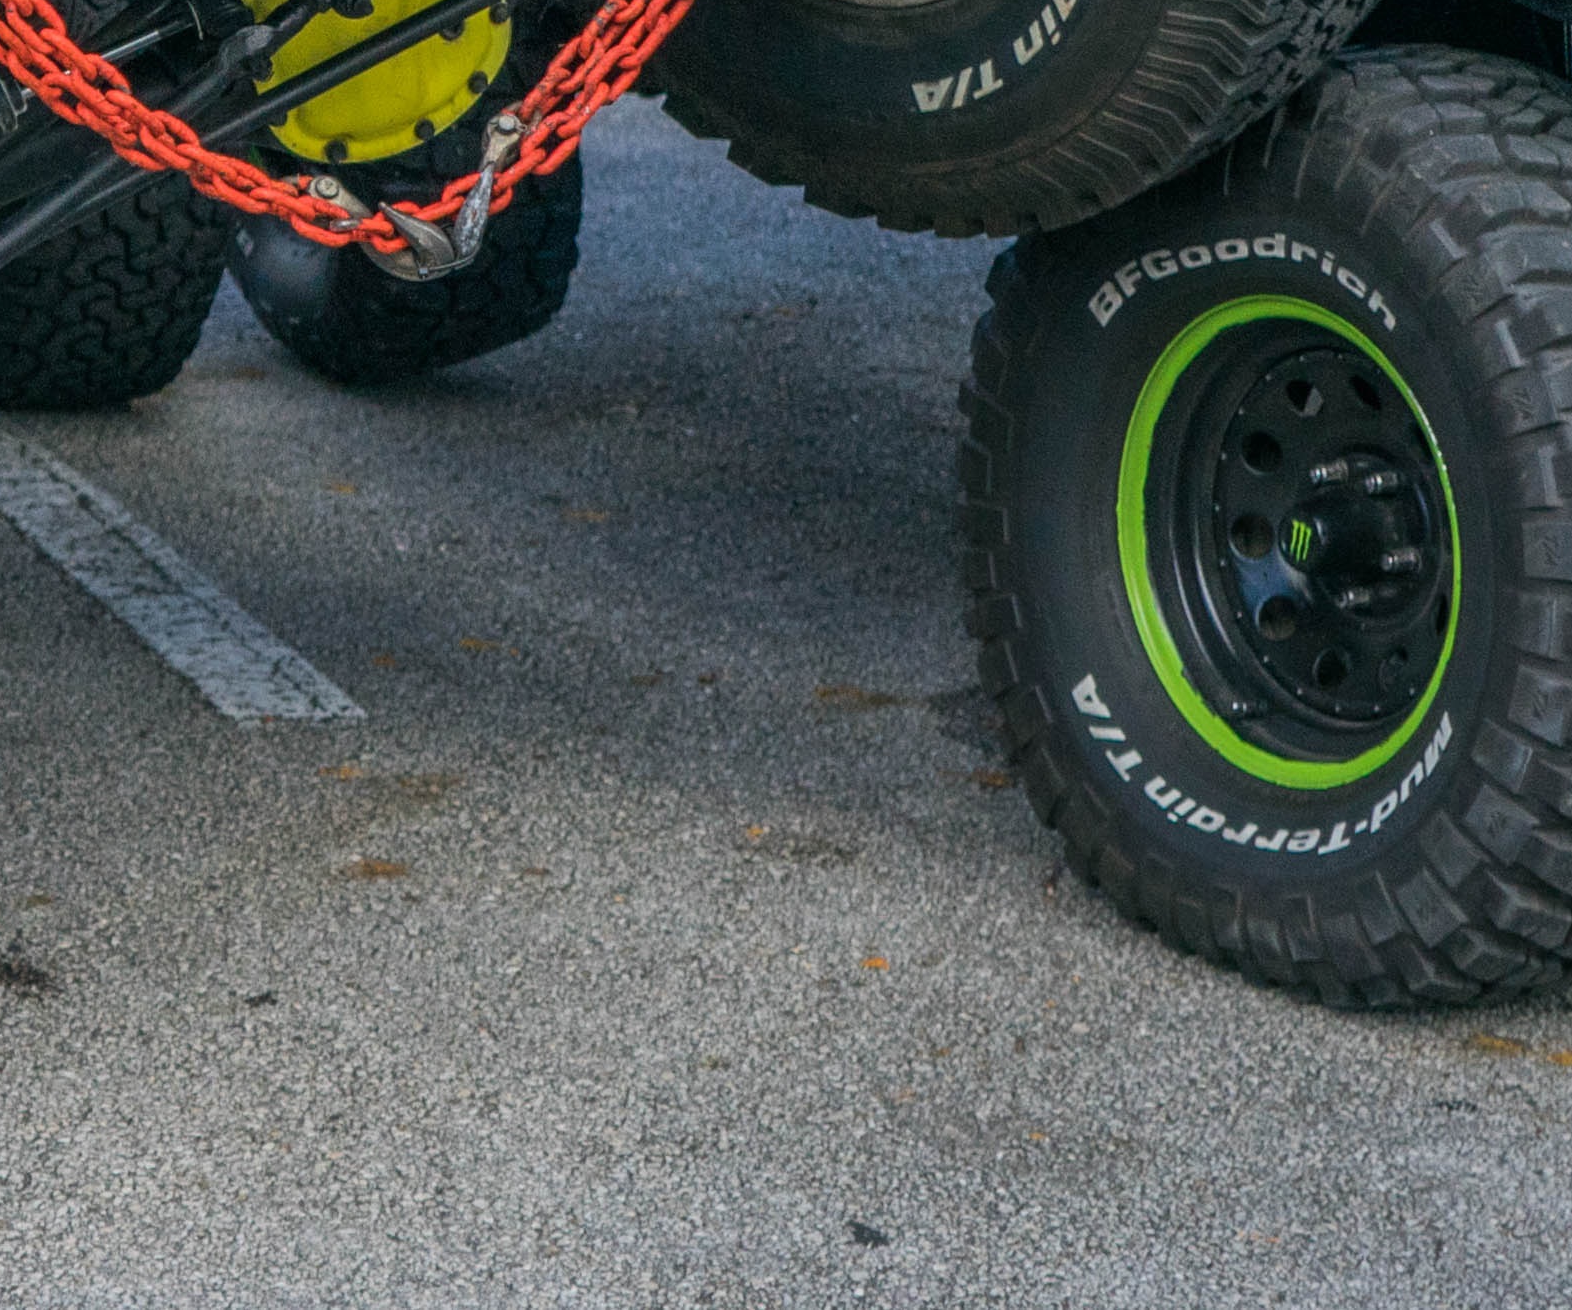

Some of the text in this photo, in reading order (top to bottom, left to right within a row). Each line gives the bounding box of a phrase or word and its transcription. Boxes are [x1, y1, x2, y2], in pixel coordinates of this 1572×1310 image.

[911, 59, 1004, 114] T/A
[1088, 233, 1397, 331] BFGoodrich
[1071, 673, 1453, 856] Mud-Terrain T/A
